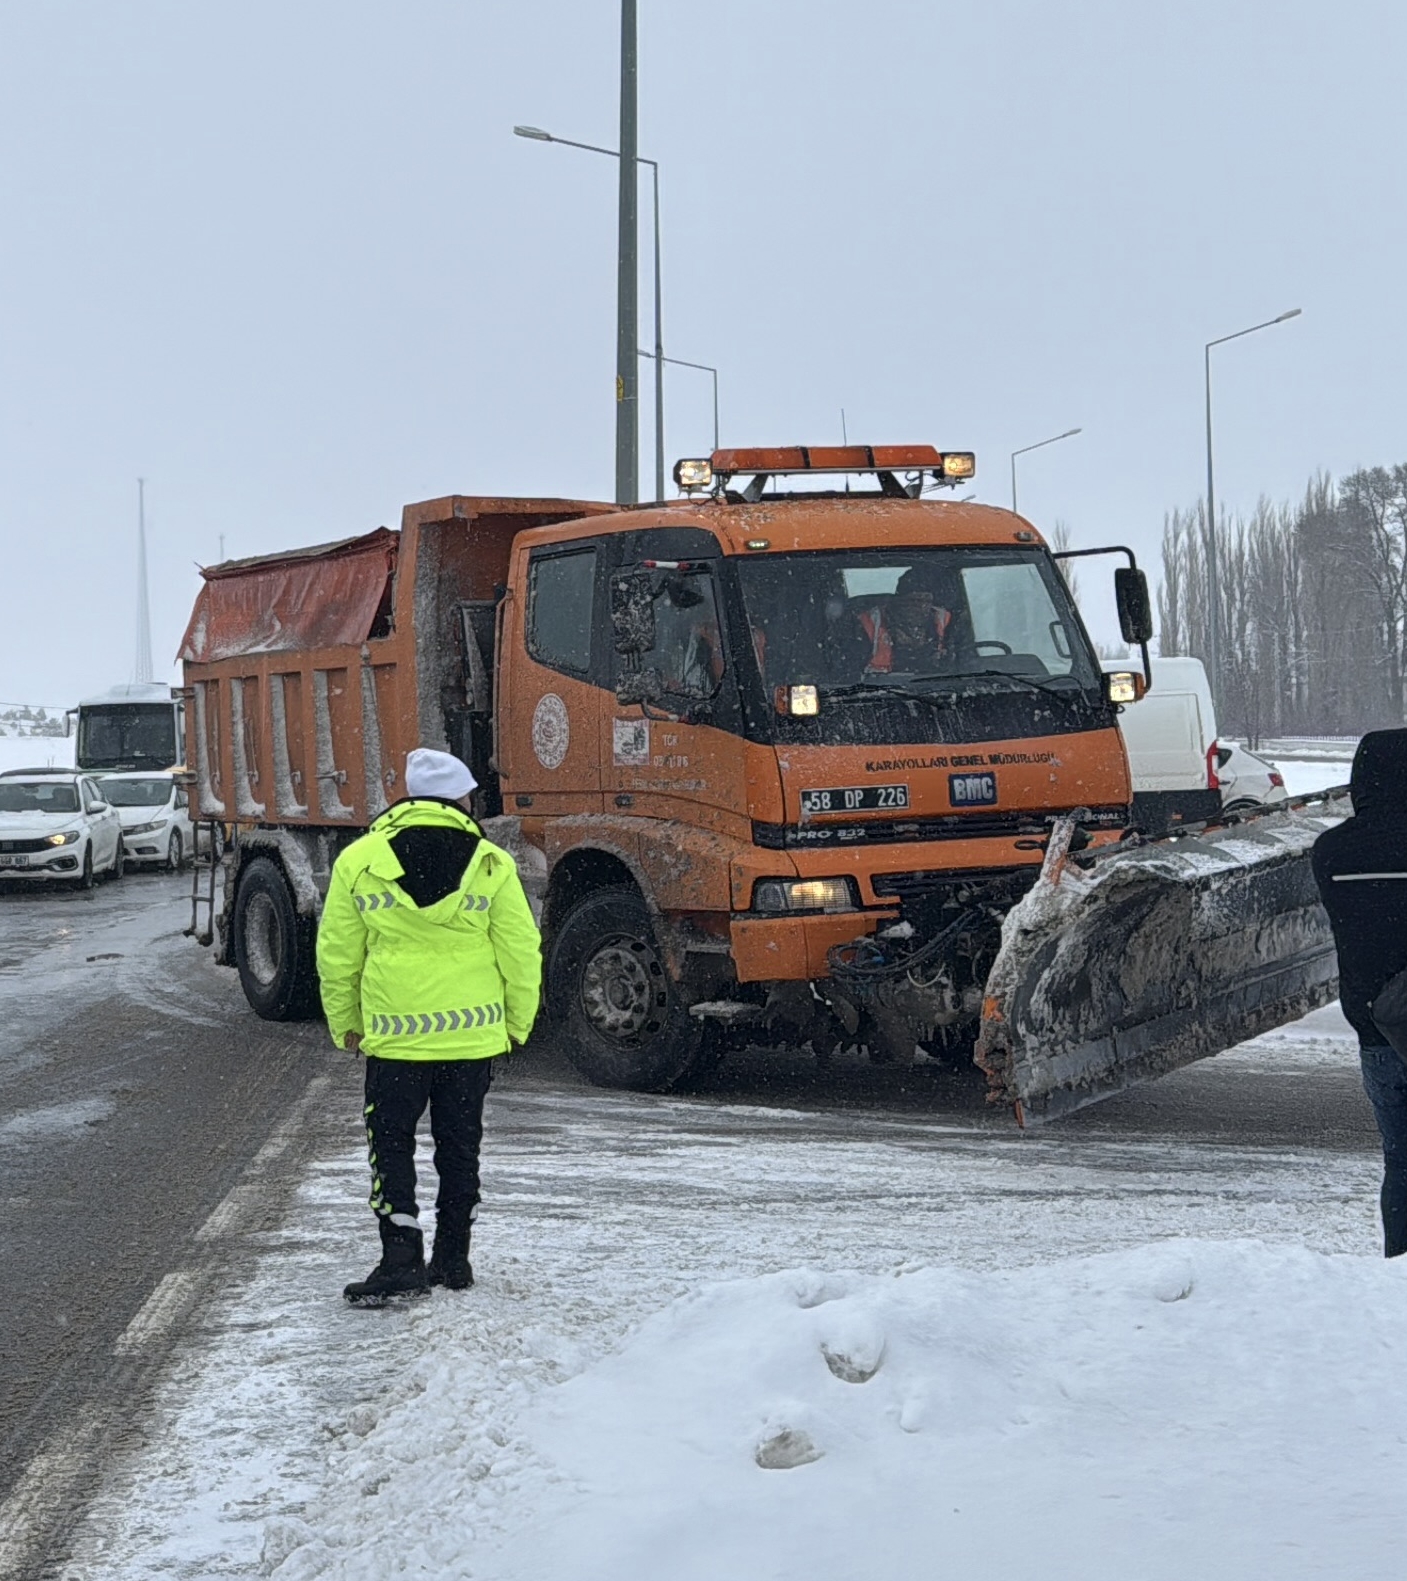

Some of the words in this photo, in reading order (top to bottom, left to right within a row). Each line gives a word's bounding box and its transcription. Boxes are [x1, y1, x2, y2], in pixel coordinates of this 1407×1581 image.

[865, 756, 948, 772] KARAYOLLARI
[951, 754, 988, 768] GENEL
[811, 792, 832, 810] 58
[844, 789, 864, 808] DP
[877, 787, 906, 806] 226
[953, 777, 994, 800] BMC
